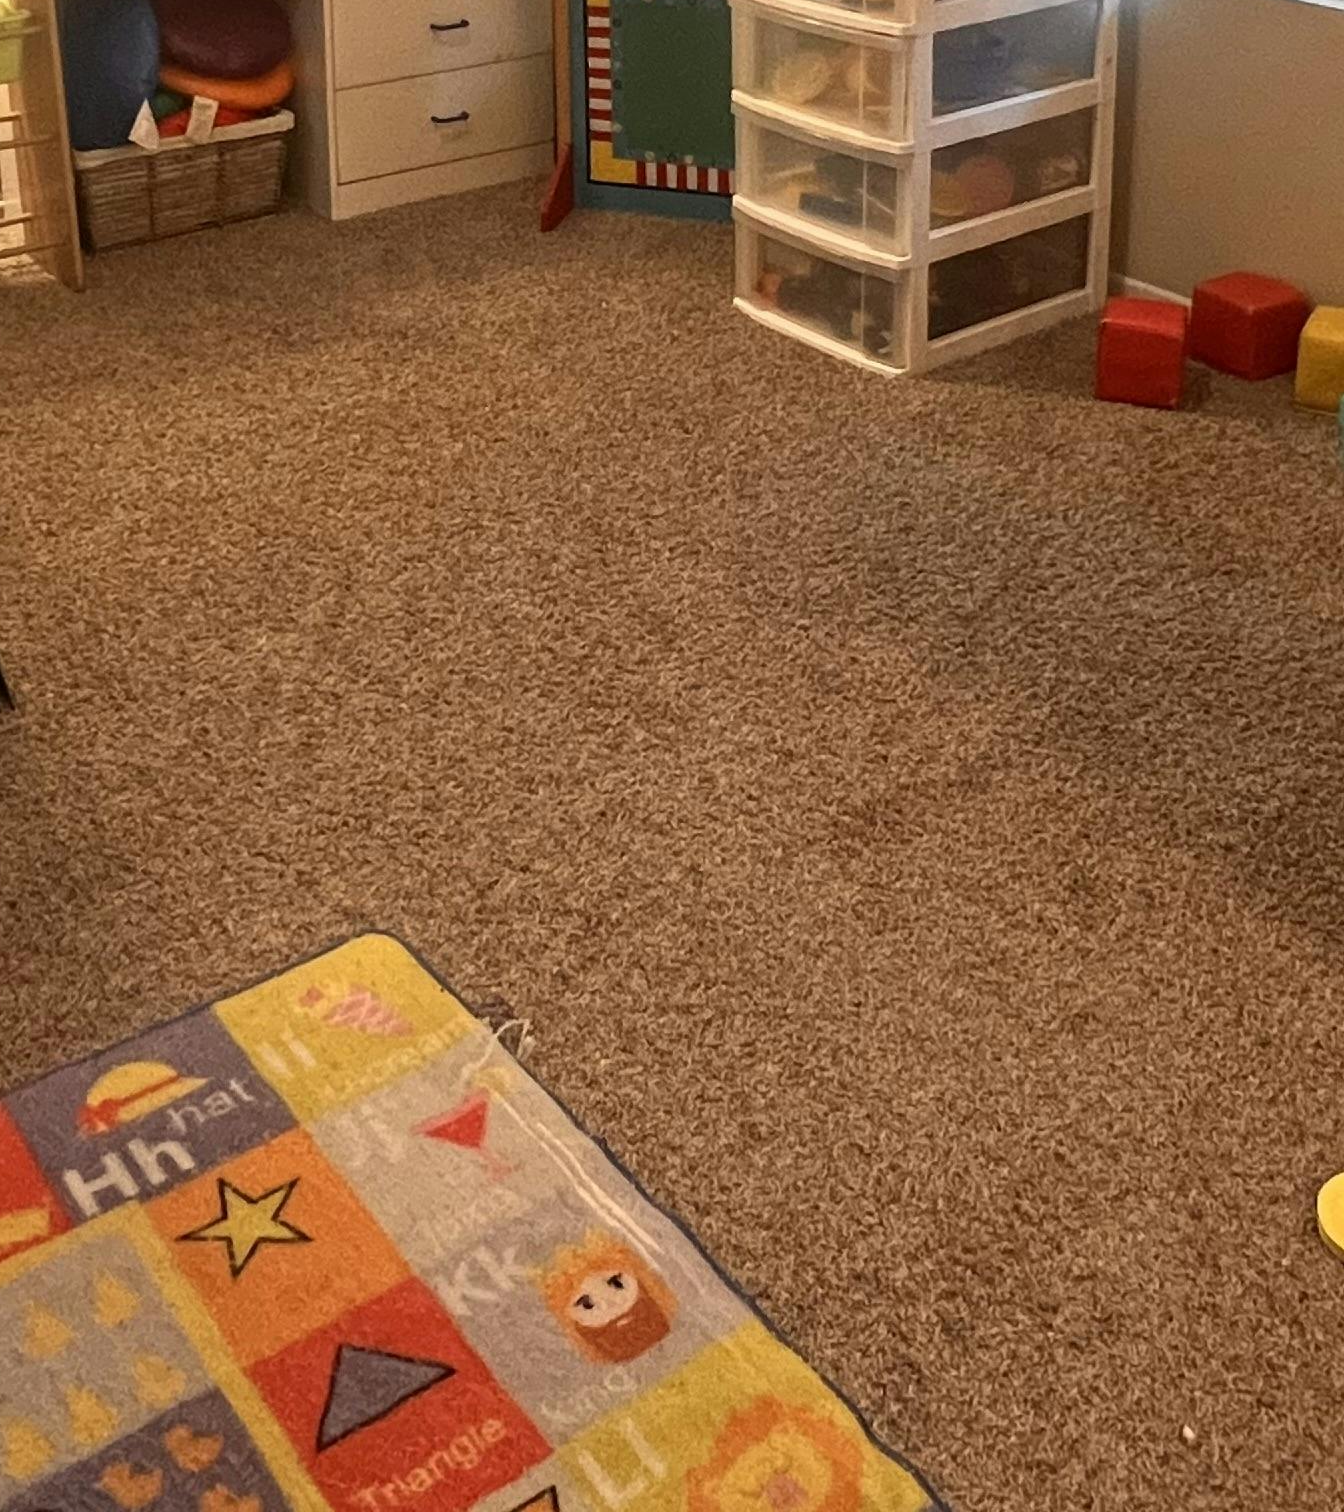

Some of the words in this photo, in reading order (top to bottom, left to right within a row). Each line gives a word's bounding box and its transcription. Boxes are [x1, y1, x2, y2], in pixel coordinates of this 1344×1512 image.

[167, 1079, 257, 1136] hat
[61, 1134, 196, 1220] Hh
[437, 1245, 530, 1318] Kk
[354, 1415, 507, 1511] Triangle
